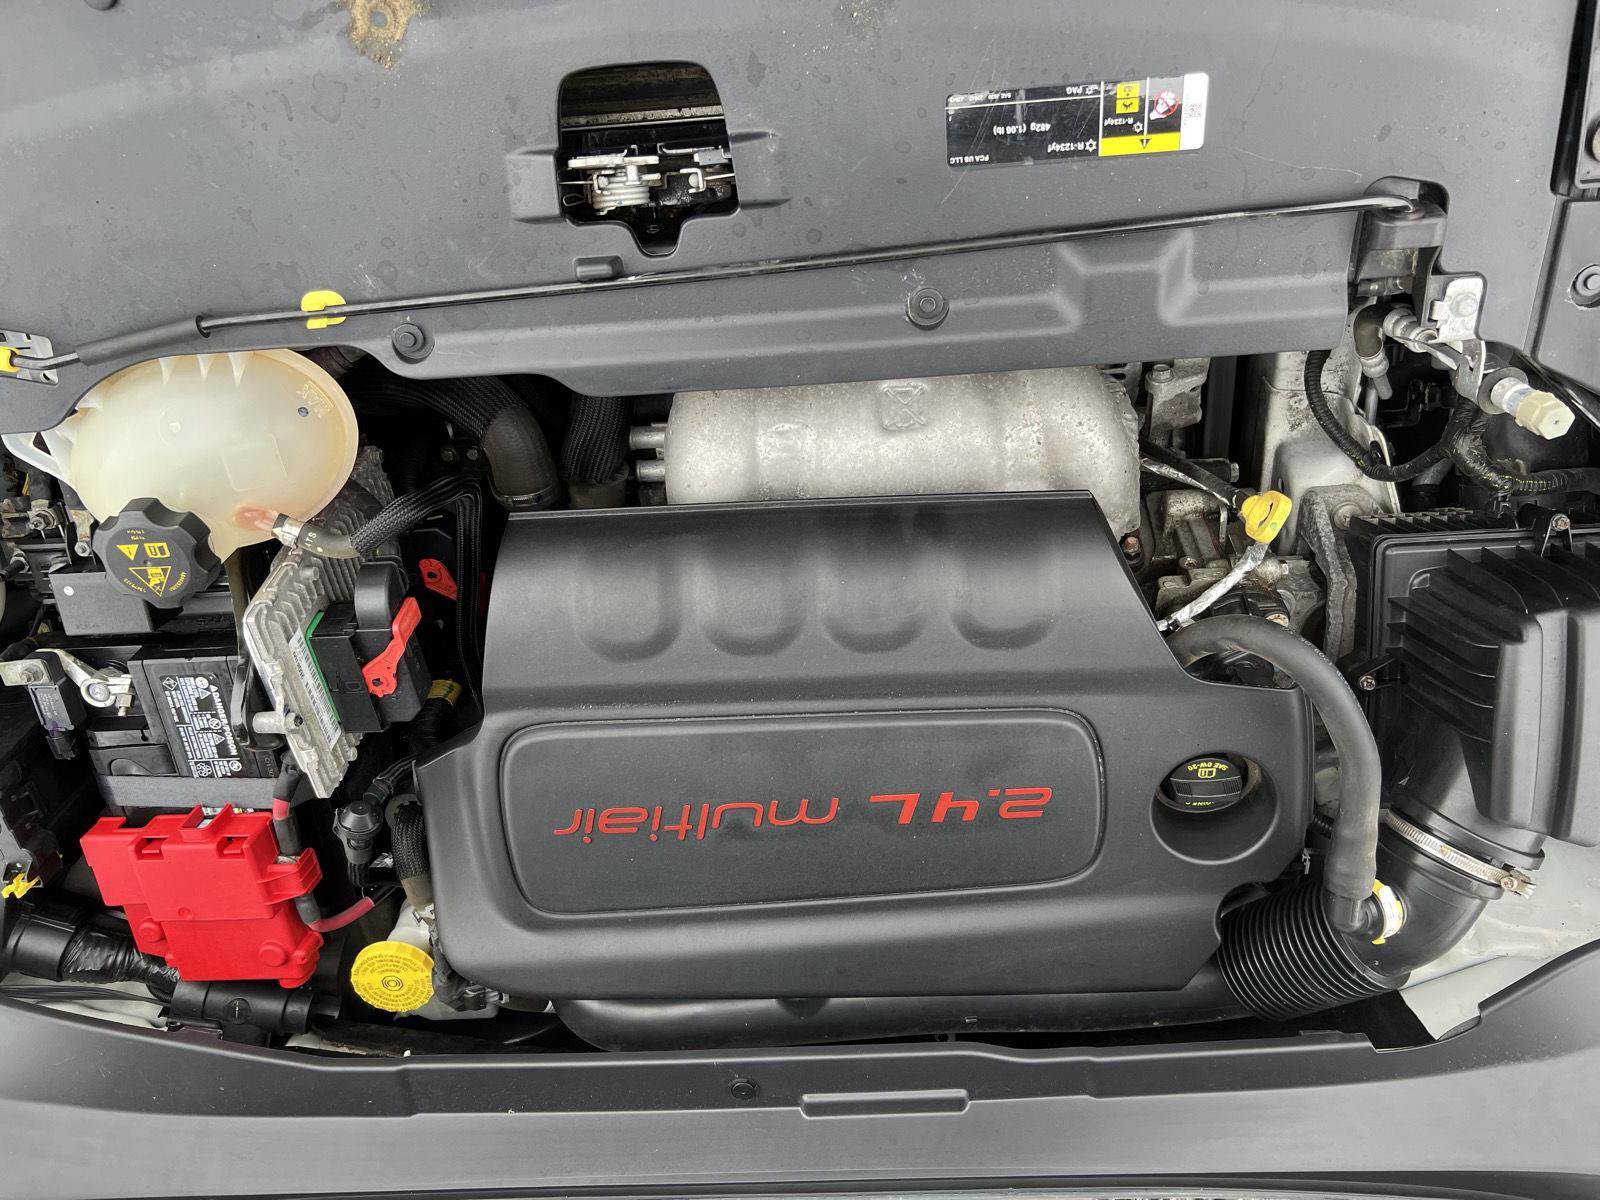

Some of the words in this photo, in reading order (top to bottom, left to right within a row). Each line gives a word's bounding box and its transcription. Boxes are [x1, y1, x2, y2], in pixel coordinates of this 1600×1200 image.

[1065, 86, 1083, 95] PAG
[1104, 117, 1134, 126] R-1234yf
[1006, 123, 1027, 134] (1.06
[1030, 121, 1051, 132] 482g
[1047, 141, 1084, 153] R-1234yf
[949, 156, 964, 164] LLC
[964, 155, 974, 163] US
[974, 154, 989, 163] FCA
[212, 692, 238, 756] DANGER/POISON
[1187, 762, 1213, 771] 0W-20
[1213, 762, 1228, 771] SAE
[869, 787, 1053, 825] 2.4L
[553, 796, 839, 844] multiair
